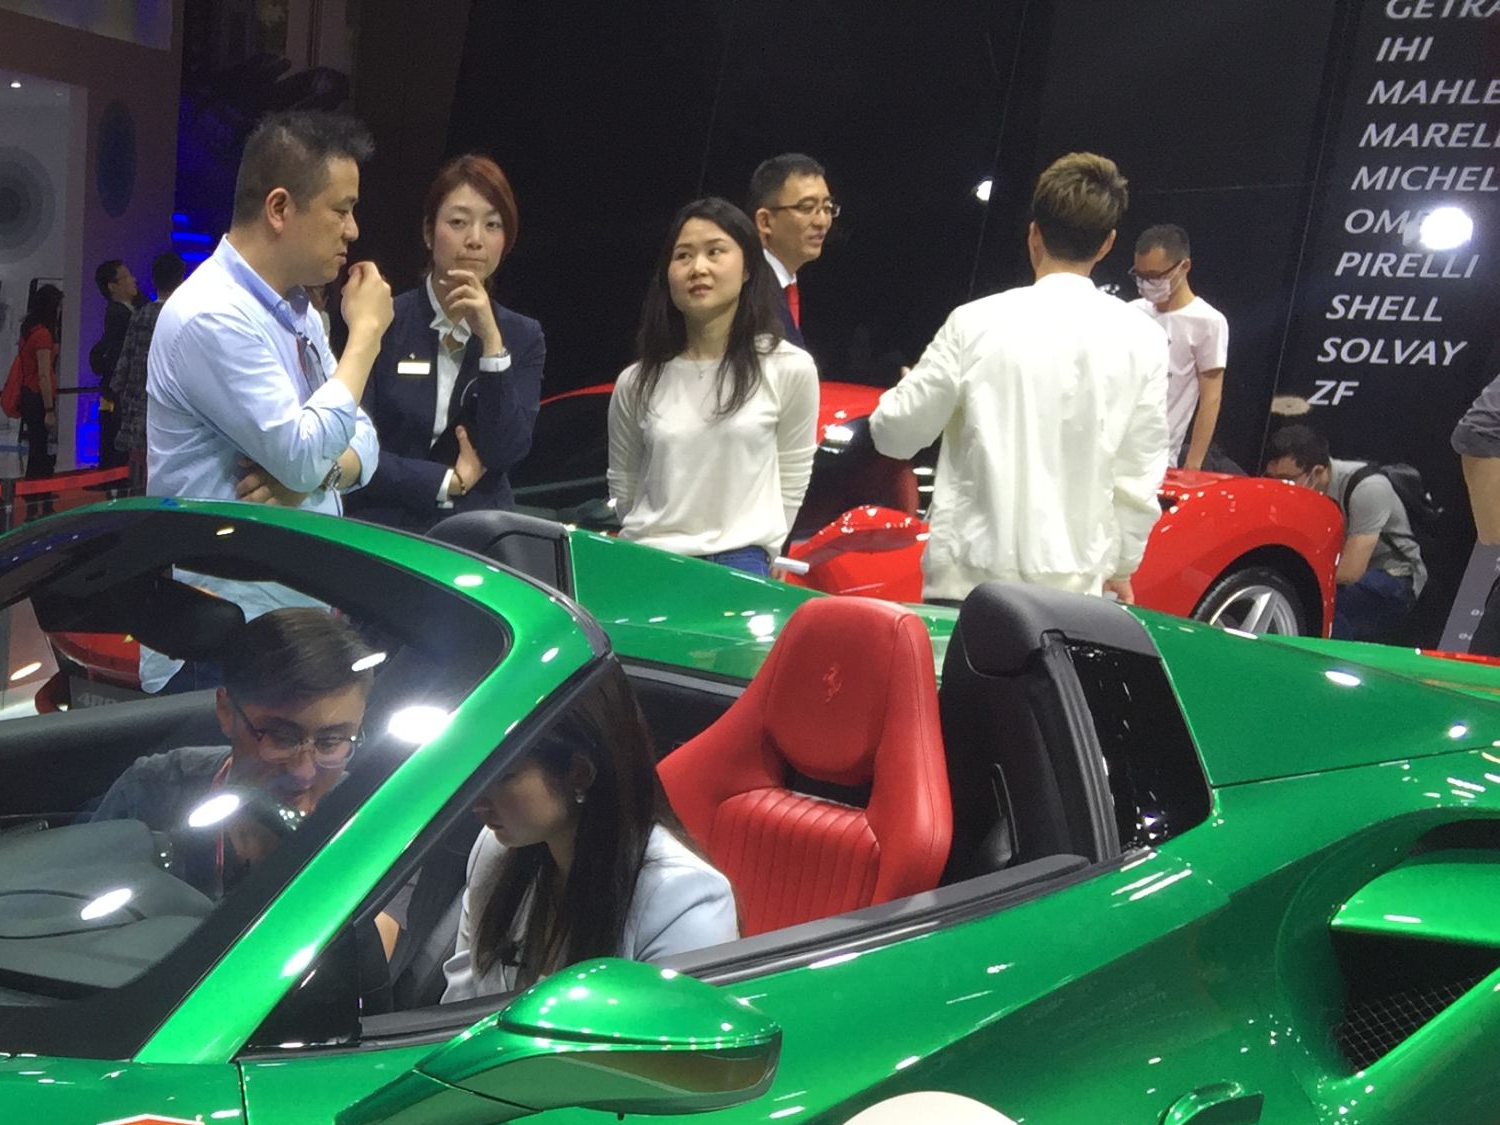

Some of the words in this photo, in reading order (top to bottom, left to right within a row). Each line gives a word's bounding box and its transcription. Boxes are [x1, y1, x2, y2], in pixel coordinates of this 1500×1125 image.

[1375, 36, 1434, 62] IHI
[1366, 79, 1500, 105] MAHLE
[1350, 165, 1500, 191] MICHEL
[1334, 251, 1480, 279] PIRELLI
[1325, 294, 1443, 322] SHELL
[1316, 337, 1468, 366] SOLVAY
[1306, 380, 1360, 406] ZF
